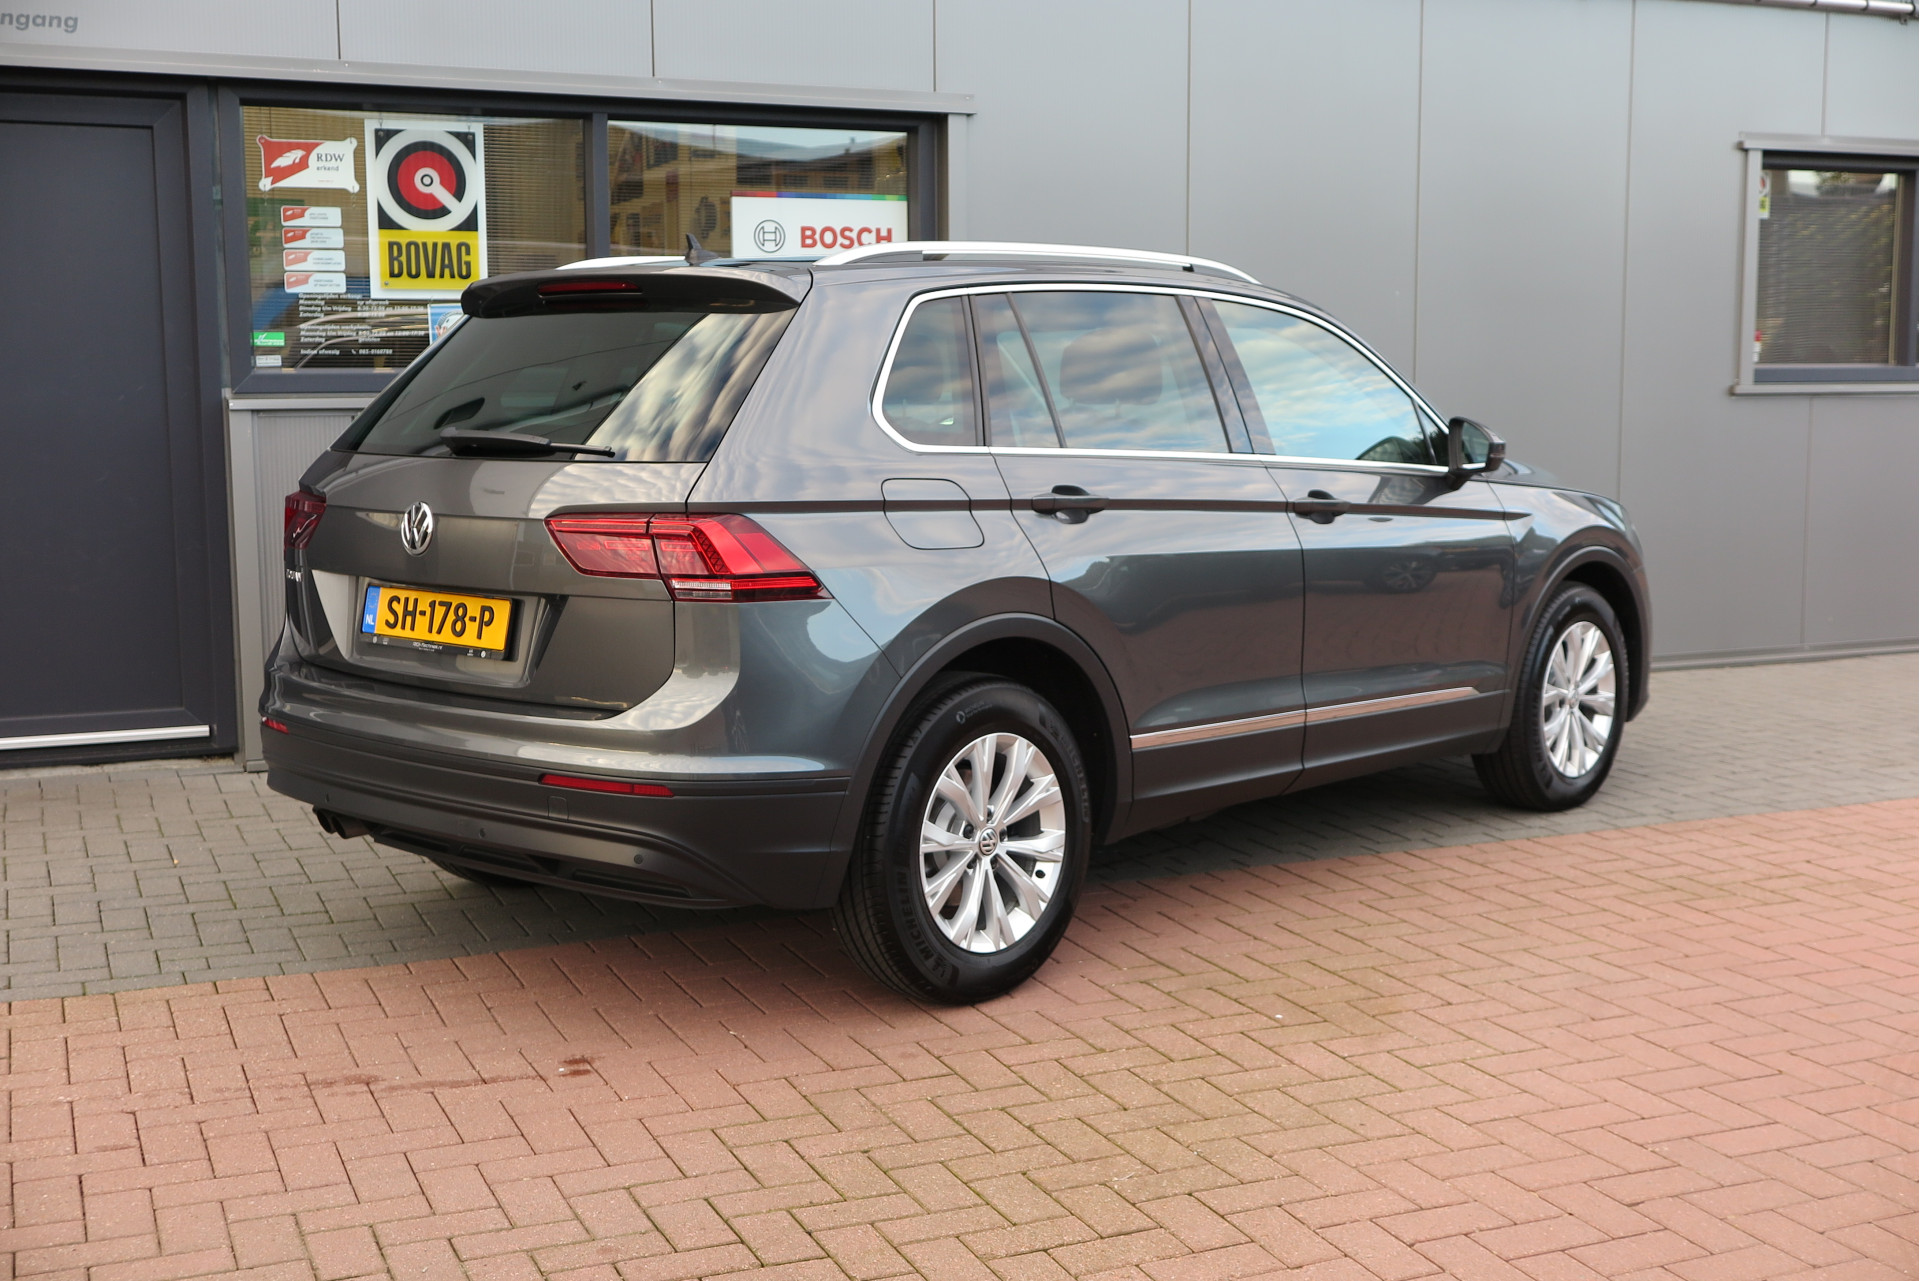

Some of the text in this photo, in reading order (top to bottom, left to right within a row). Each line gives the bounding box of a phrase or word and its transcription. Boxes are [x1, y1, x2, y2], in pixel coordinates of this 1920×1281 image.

[316, 152, 345, 162] RDW
[800, 226, 892, 249] BOSCH
[387, 241, 472, 279] BOVAG
[365, 614, 375, 626] NL
[385, 595, 495, 640] SH-178-P
